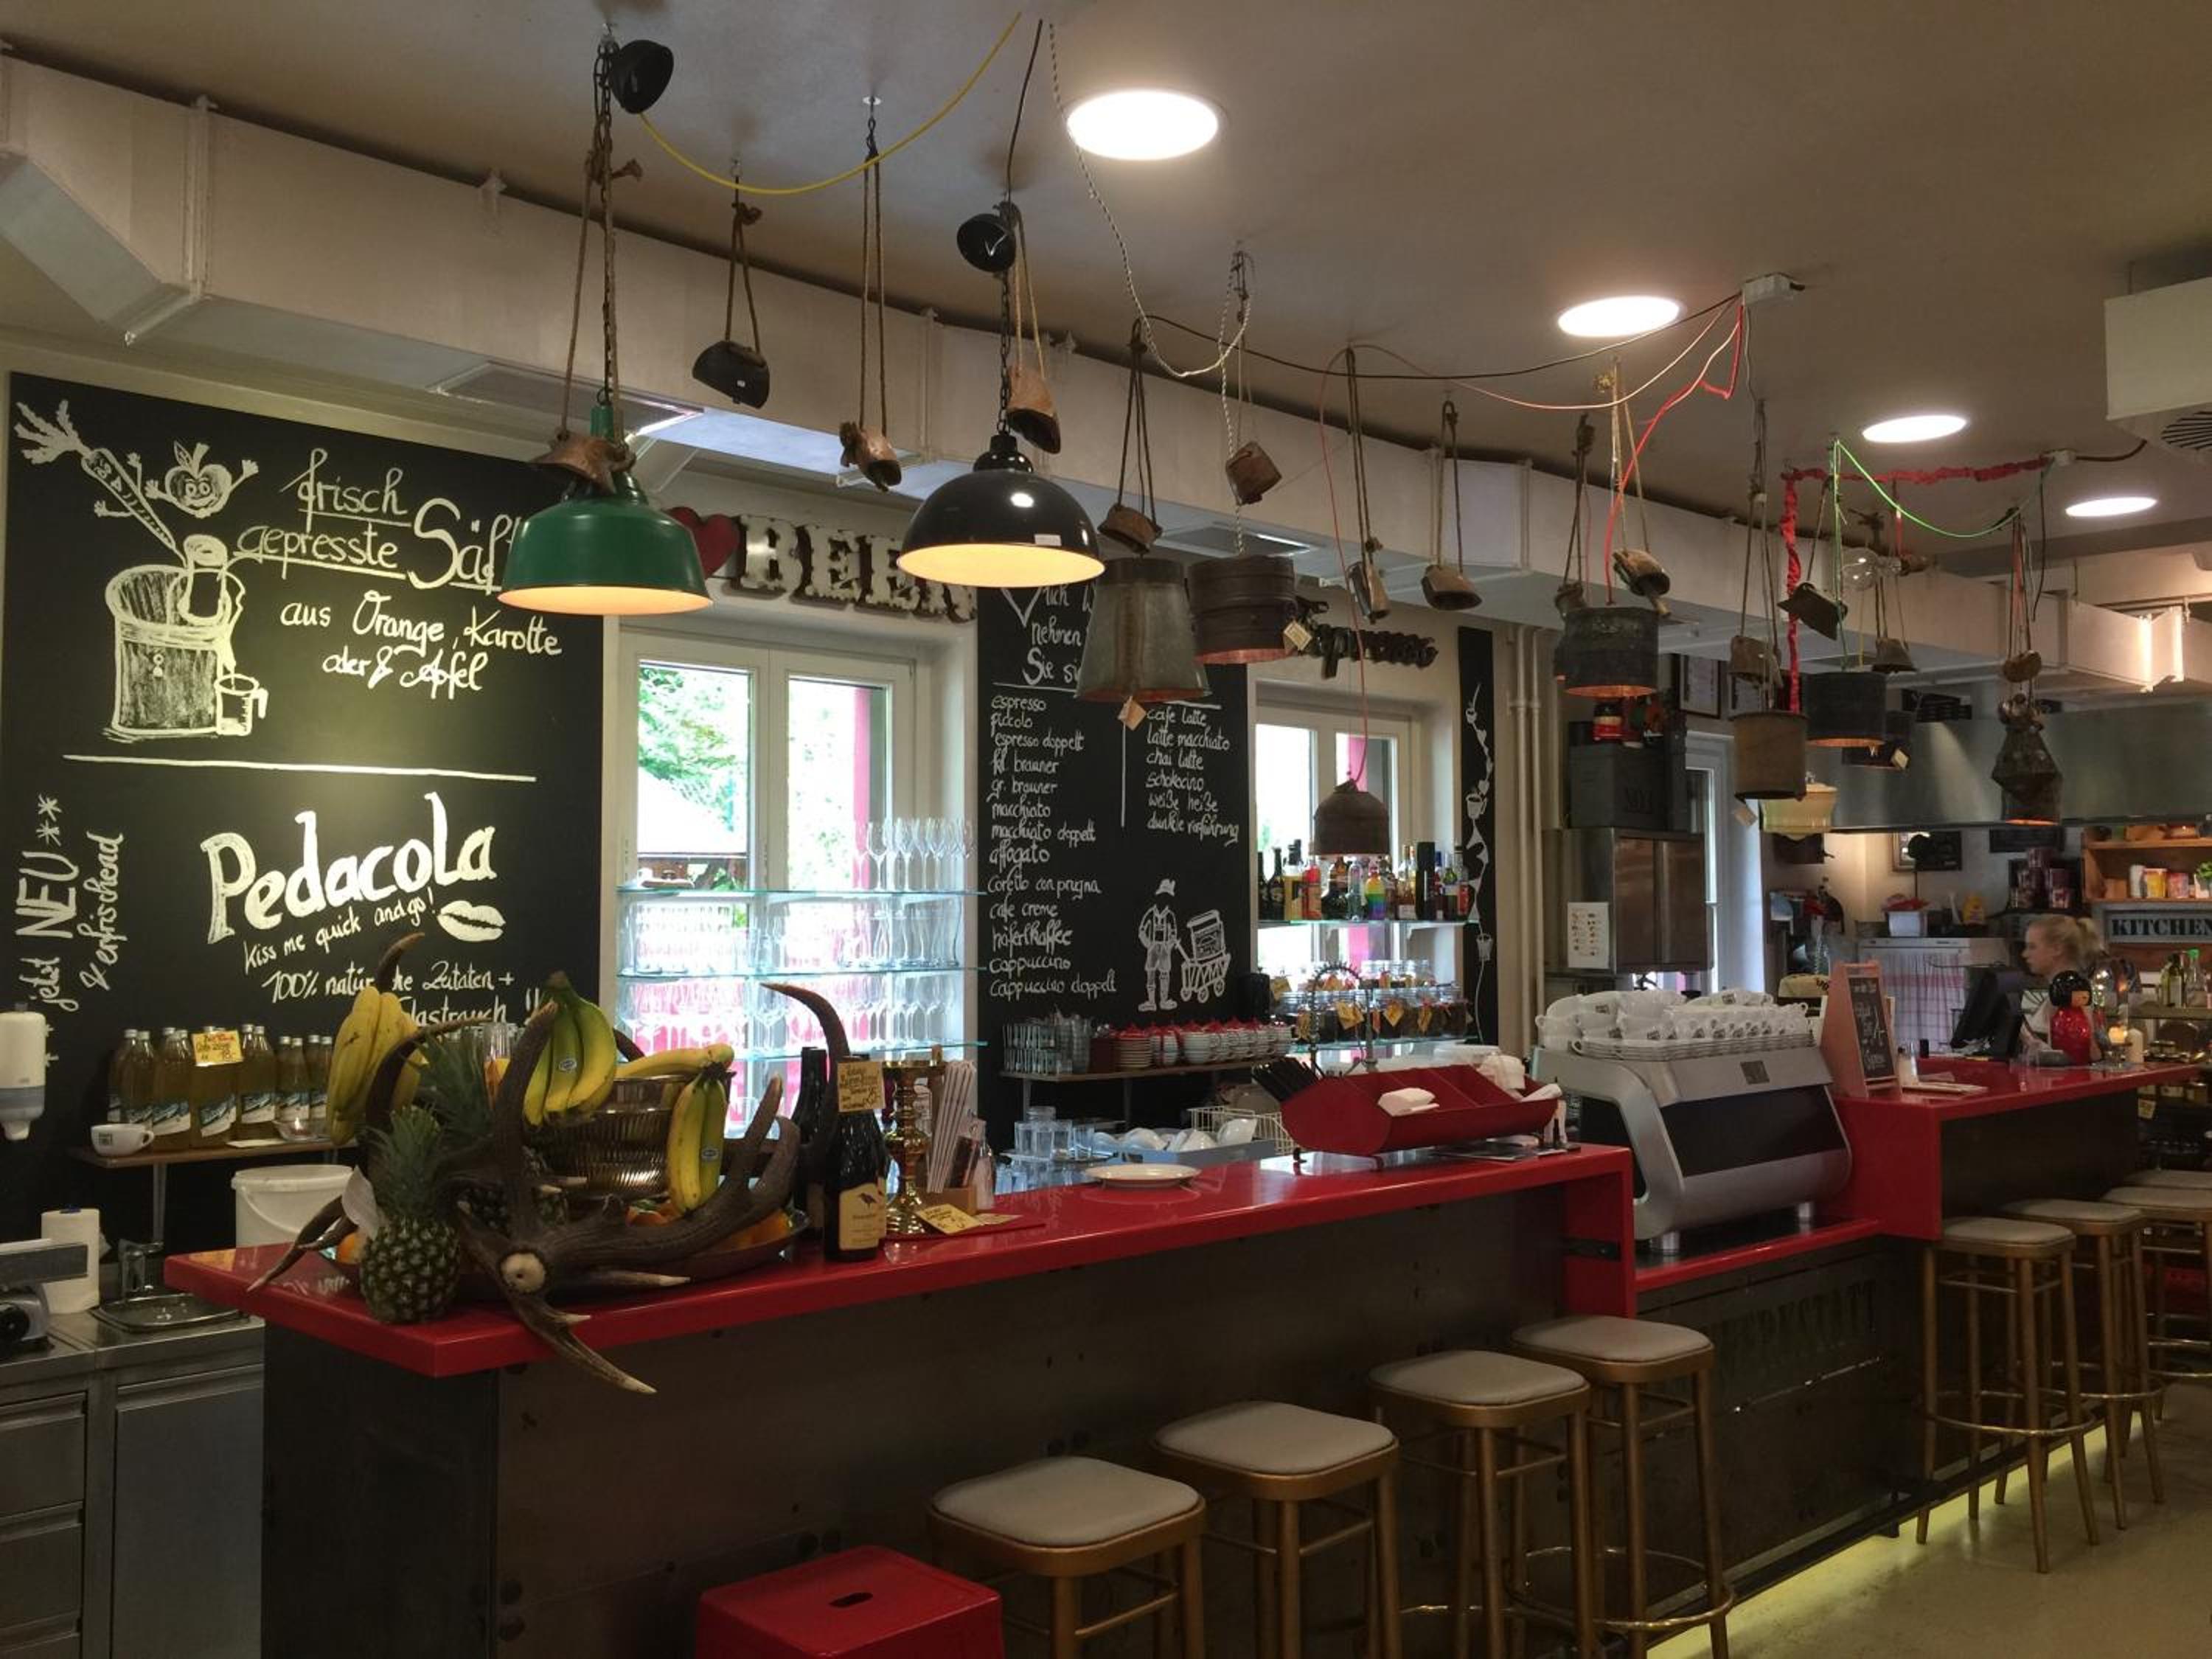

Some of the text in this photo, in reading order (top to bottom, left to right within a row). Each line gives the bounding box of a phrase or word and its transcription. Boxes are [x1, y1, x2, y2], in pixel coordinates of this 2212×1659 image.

[279, 448, 408, 532] frisch
[237, 521, 398, 580] gepresste
[407, 498, 521, 594] Säf
[280, 602, 331, 627] aus
[463, 606, 563, 655] Karotte
[322, 645, 369, 674] oder
[399, 649, 488, 699] Apfel
[1022, 647, 1054, 686] Sie
[991, 695, 1047, 718] espresso
[991, 711, 1033, 737] piccolo
[1182, 707, 1207, 726] latte
[995, 732, 1038, 749] espresso
[1147, 723, 1230, 751] latte macchiato
[1014, 750, 1059, 773] brauner
[1147, 746, 1204, 770] chai latte
[1012, 776, 1058, 793] brauner
[992, 793, 1051, 819] macchiato
[992, 818, 1051, 841] macchiato
[200, 791, 497, 945] Pedacola
[989, 839, 1051, 874] affogato
[77, 830, 128, 965] erfrischend
[15, 850, 79, 1012] jetzt NEU
[283, 934, 305, 956] me
[316, 905, 362, 954] quick
[262, 969, 319, 1004] 100%
[422, 961, 495, 991] Zutaten
